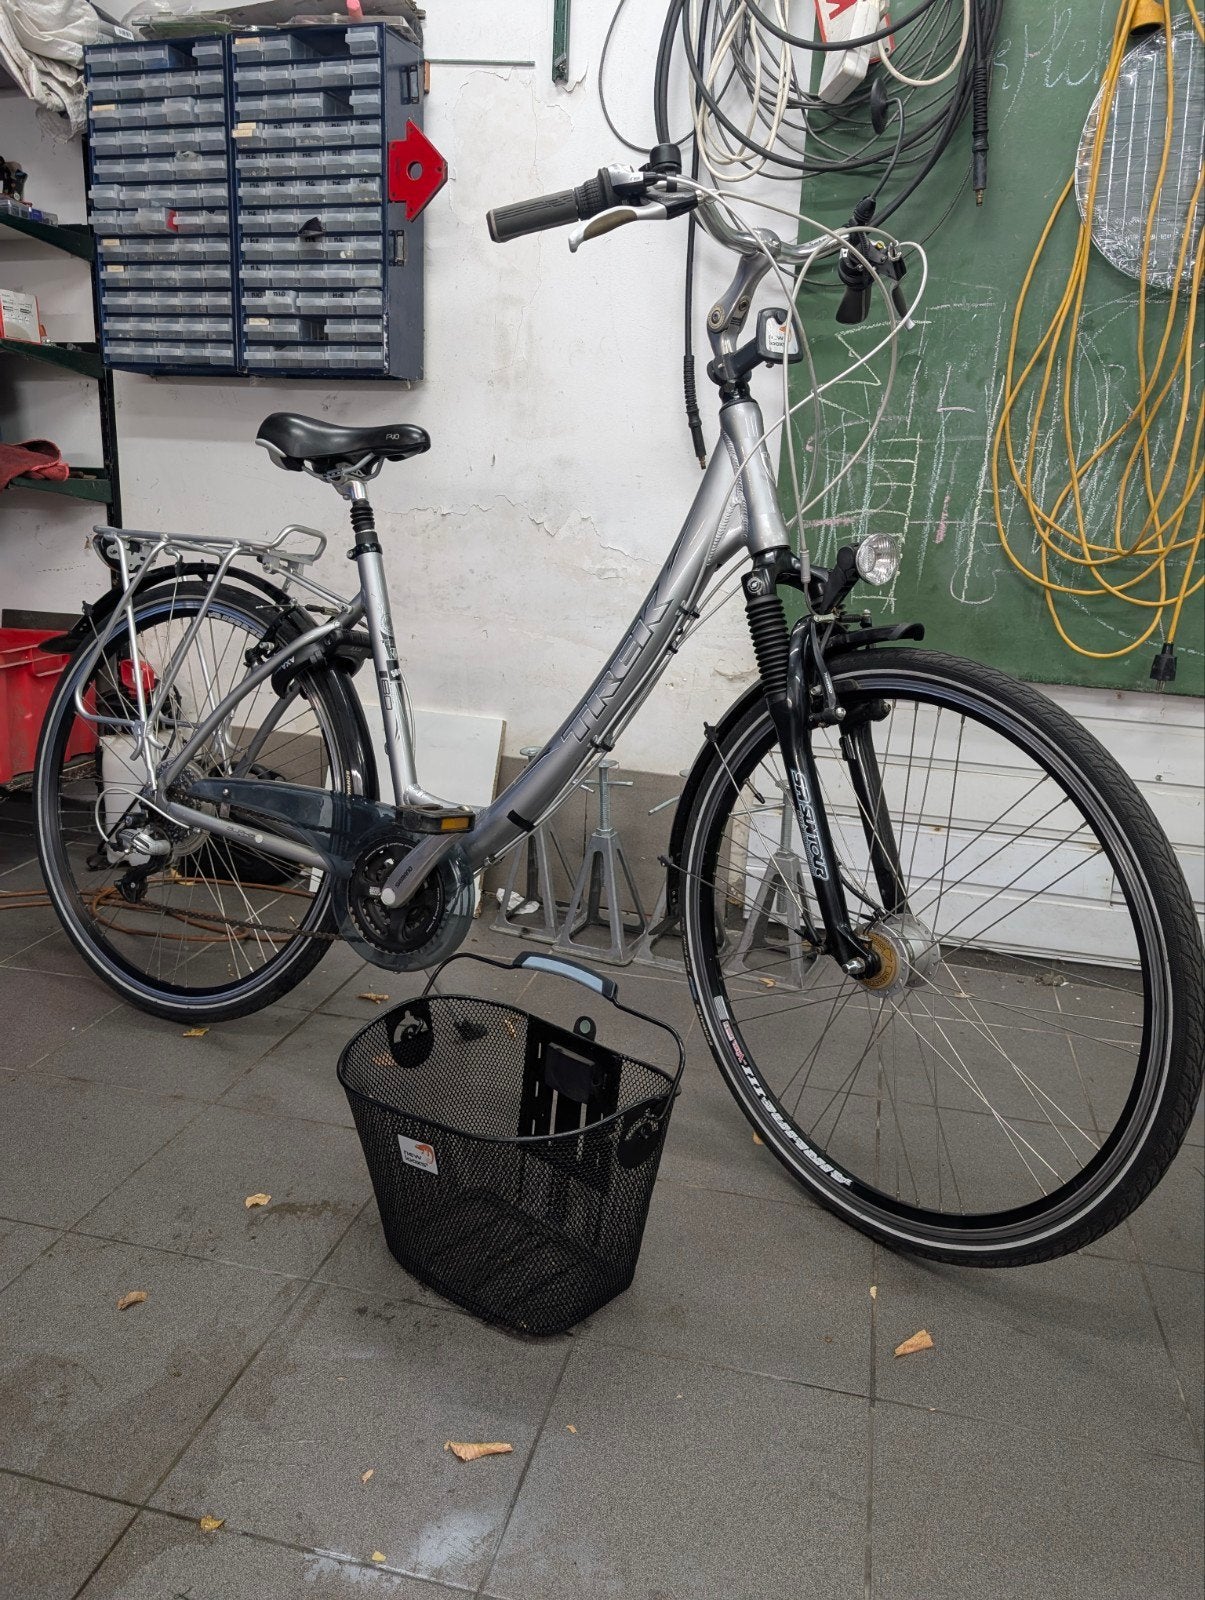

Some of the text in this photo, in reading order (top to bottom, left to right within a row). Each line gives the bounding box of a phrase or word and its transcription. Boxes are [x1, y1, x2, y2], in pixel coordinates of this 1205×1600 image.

[561, 587, 675, 743] TREK
[790, 767, 812, 804] SR
[800, 801, 830, 881] SUNTOUR
